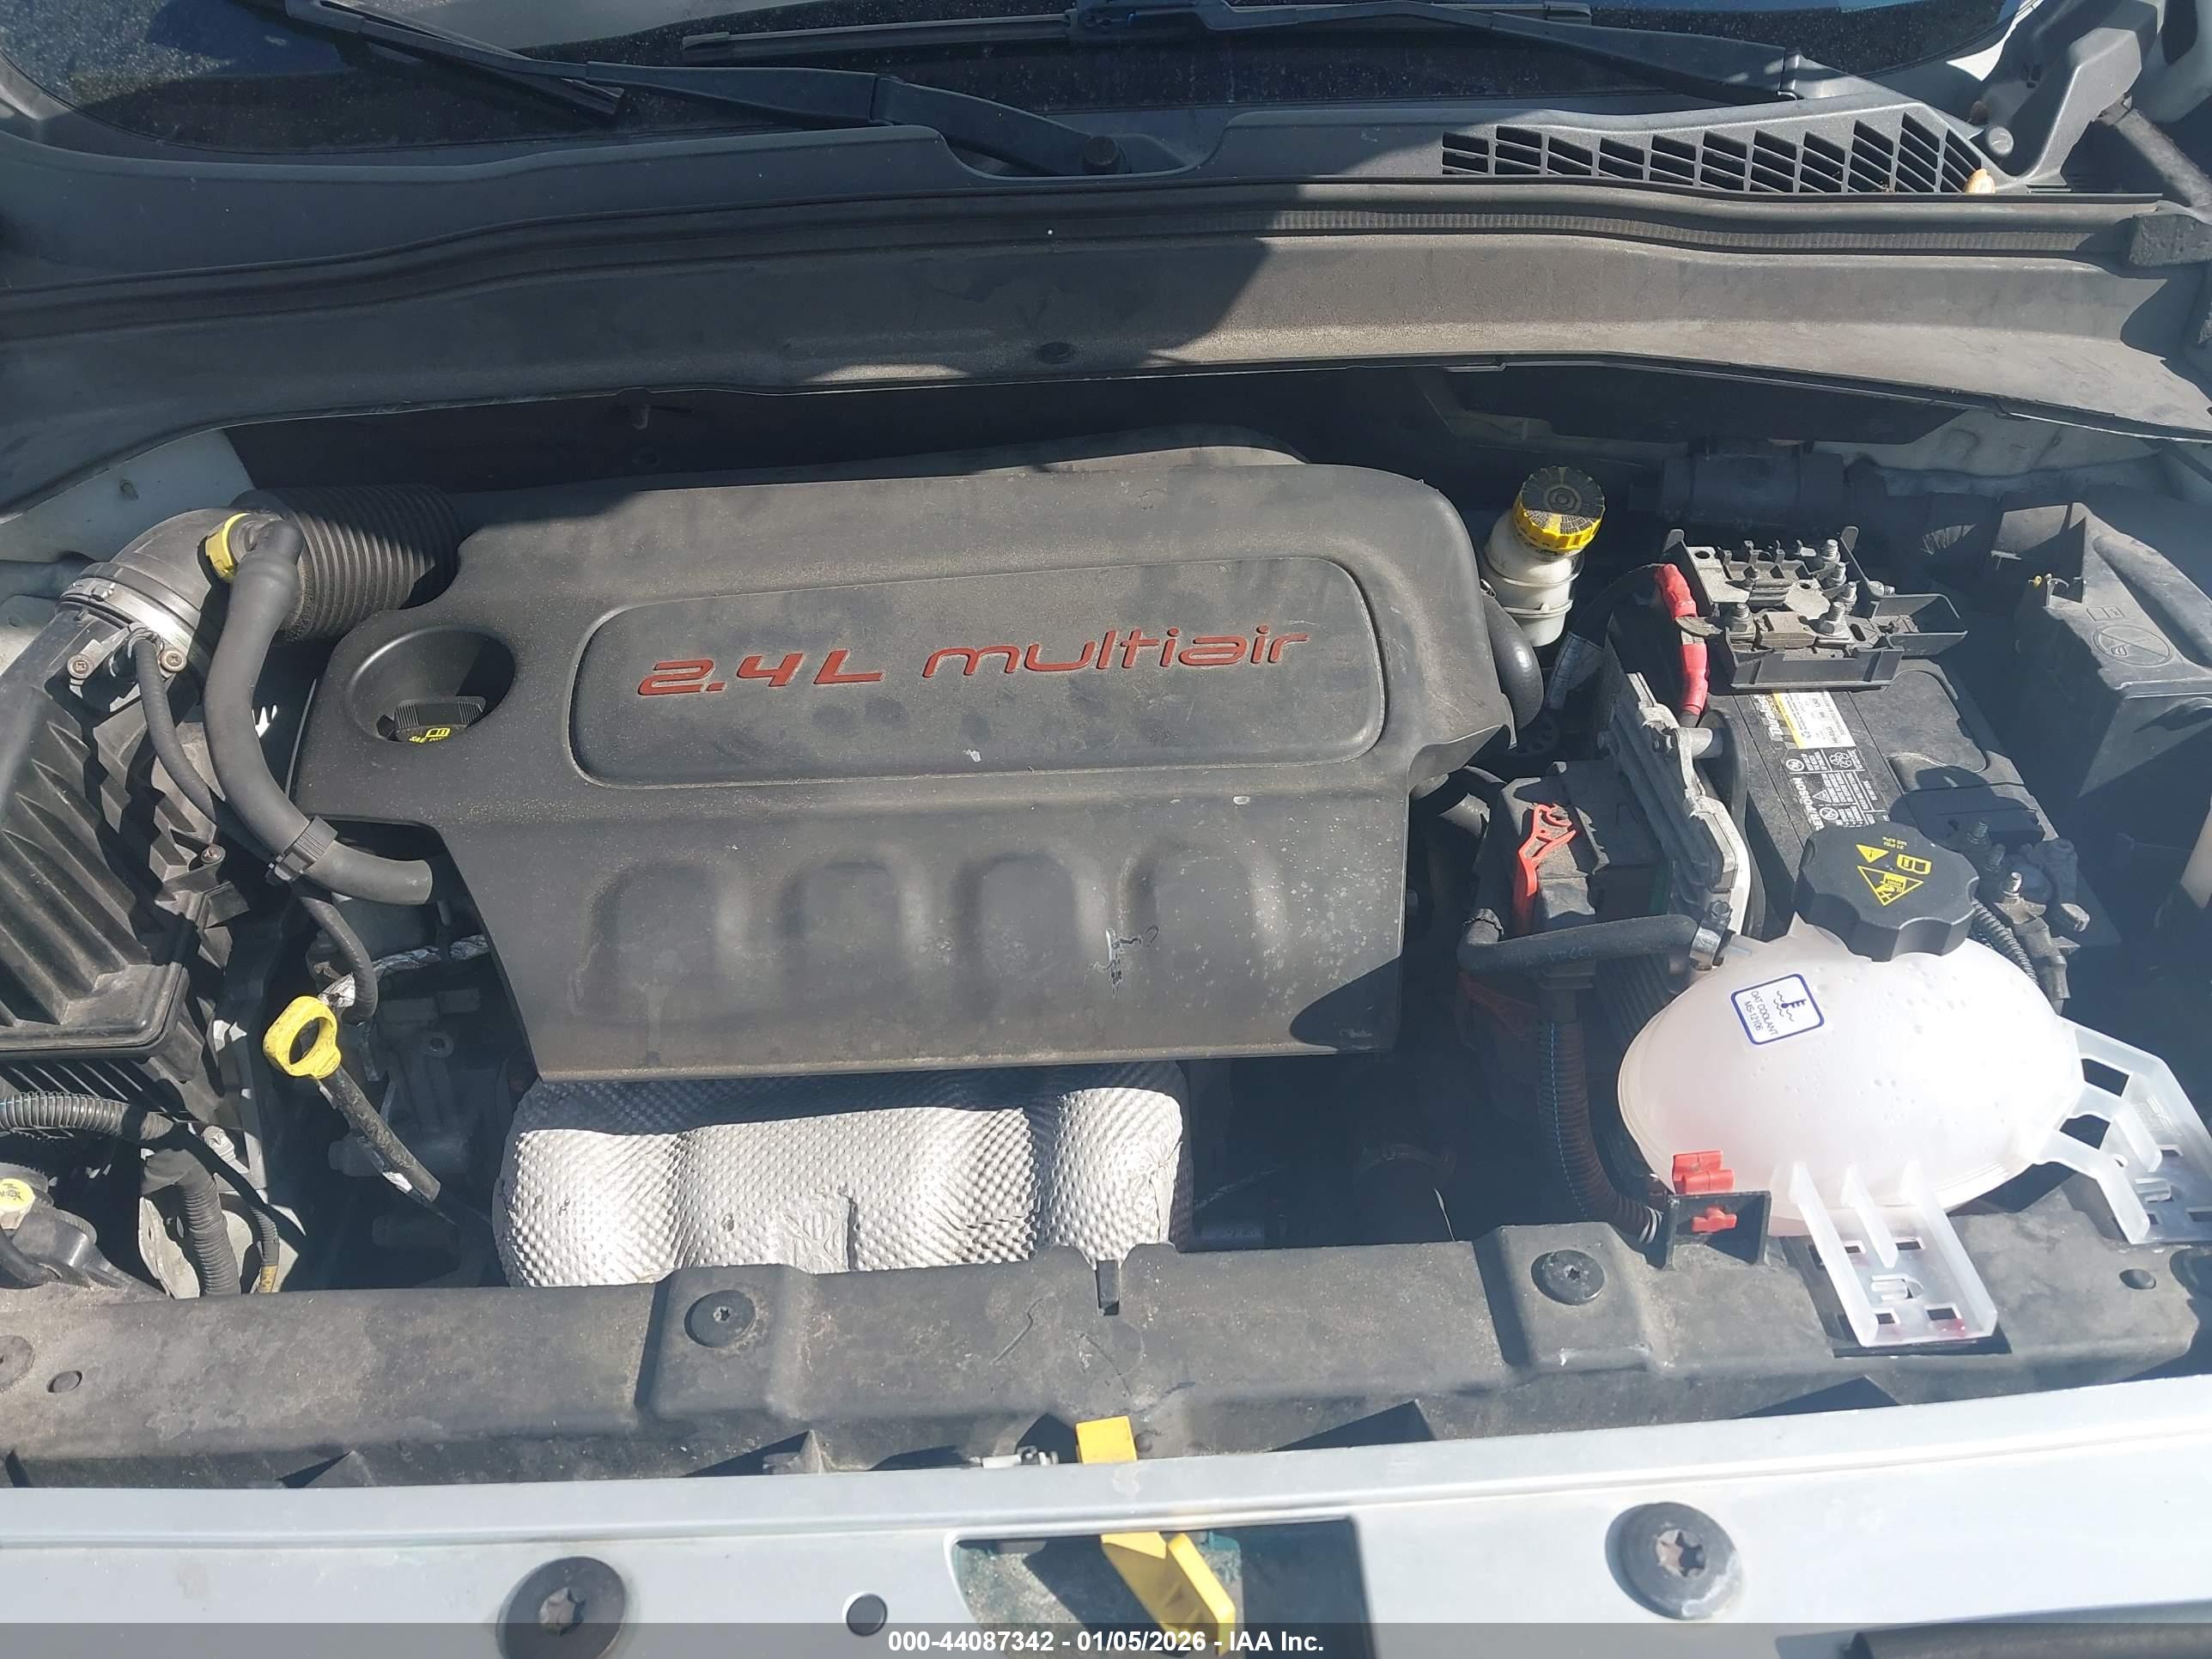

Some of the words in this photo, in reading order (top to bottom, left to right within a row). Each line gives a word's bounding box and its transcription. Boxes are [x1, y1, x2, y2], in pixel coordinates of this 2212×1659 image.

[638, 648, 884, 696] 2.4L
[921, 624, 1310, 678] multiair
[1754, 695, 1784, 738] Duralast
[1751, 990, 1763, 1003] OAT
[1757, 1004, 1778, 1036] COOLANT
